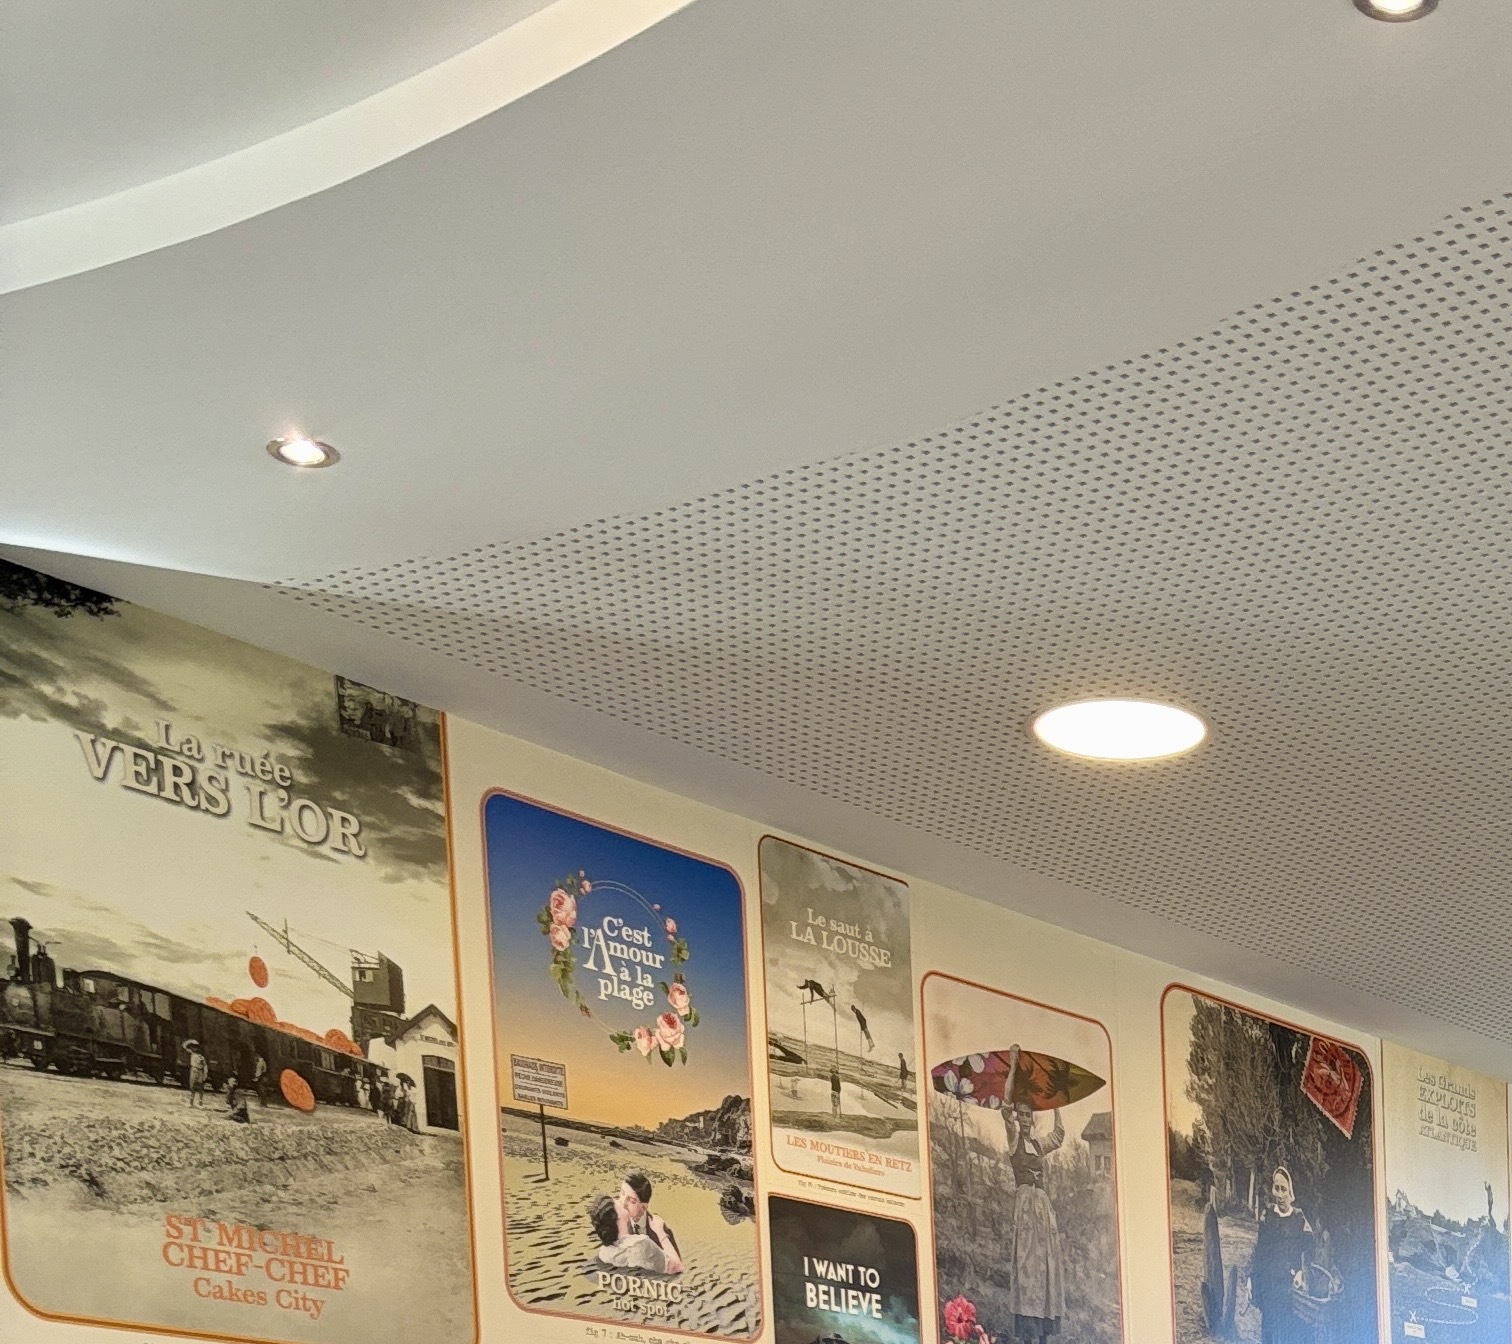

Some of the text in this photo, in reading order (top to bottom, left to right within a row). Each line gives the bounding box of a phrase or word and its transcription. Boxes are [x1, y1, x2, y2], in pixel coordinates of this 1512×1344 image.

[156, 720, 293, 787] La ruée
[73, 731, 366, 857] VERS L'OR
[603, 916, 652, 948] C'est
[807, 907, 874, 943] Le saut à
[581, 926, 665, 976] l'Amour
[789, 920, 892, 968] LA LOUSSE
[597, 976, 655, 1010] plage
[620, 961, 655, 988] à la
[1418, 1103, 1434, 1124] de
[1436, 1108, 1449, 1130] la
[786, 1134, 912, 1172] LES MOUTIERS EN RETZ
[165, 1213, 345, 1266] ST MICHEL
[162, 1240, 350, 1291] CHEF-CHEF
[803, 1256, 880, 1288] I WANT TO
[193, 1276, 326, 1320] Cakes City
[597, 1271, 683, 1303] PORNIC
[805, 1282, 882, 1319] BELIEVE
[613, 1298, 670, 1317] hot spot
